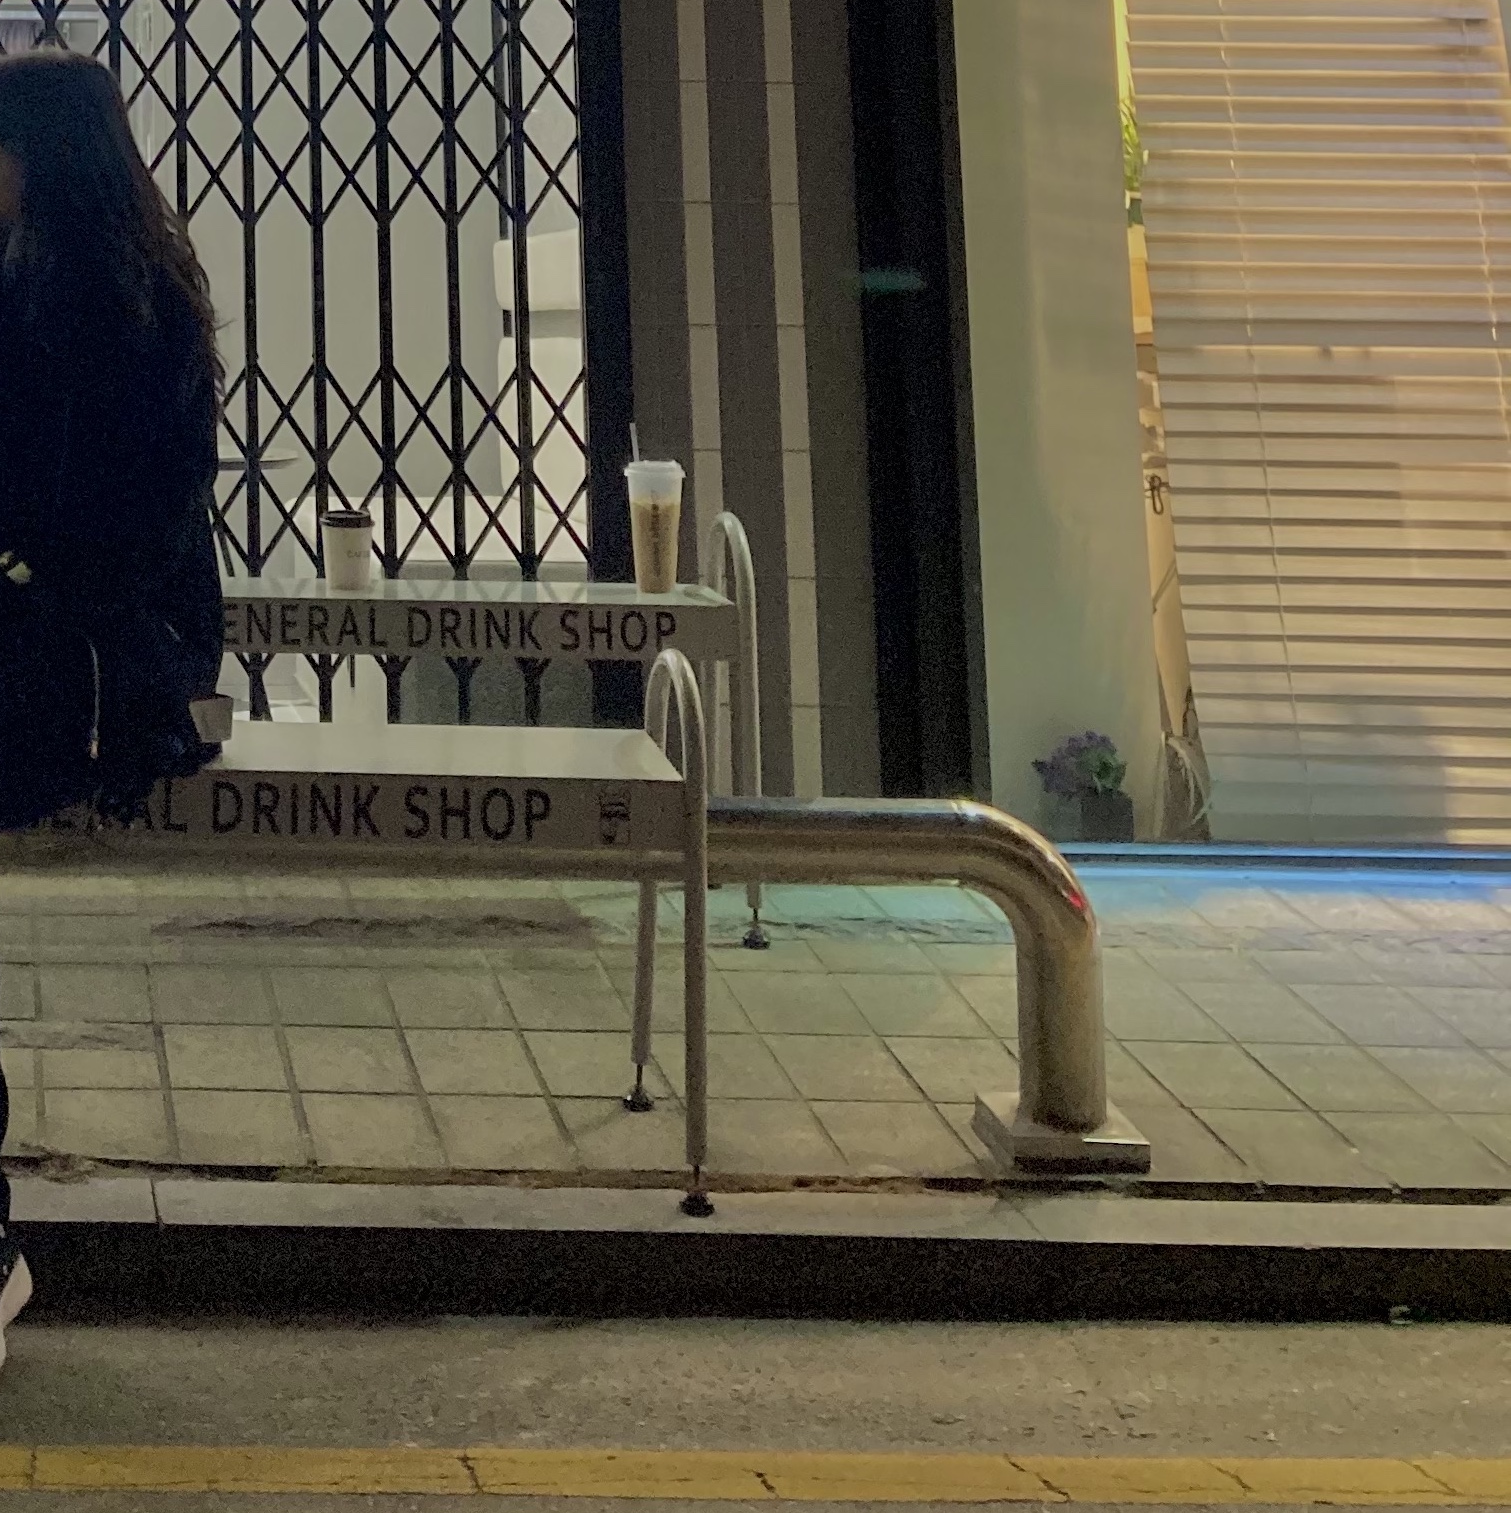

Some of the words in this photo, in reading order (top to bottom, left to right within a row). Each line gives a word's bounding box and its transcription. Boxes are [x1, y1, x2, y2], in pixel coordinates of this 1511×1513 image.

[407, 606, 543, 651] DRINK
[559, 609, 677, 653] SHOP
[211, 779, 382, 839] DRINK
[403, 784, 551, 842] SHOP
